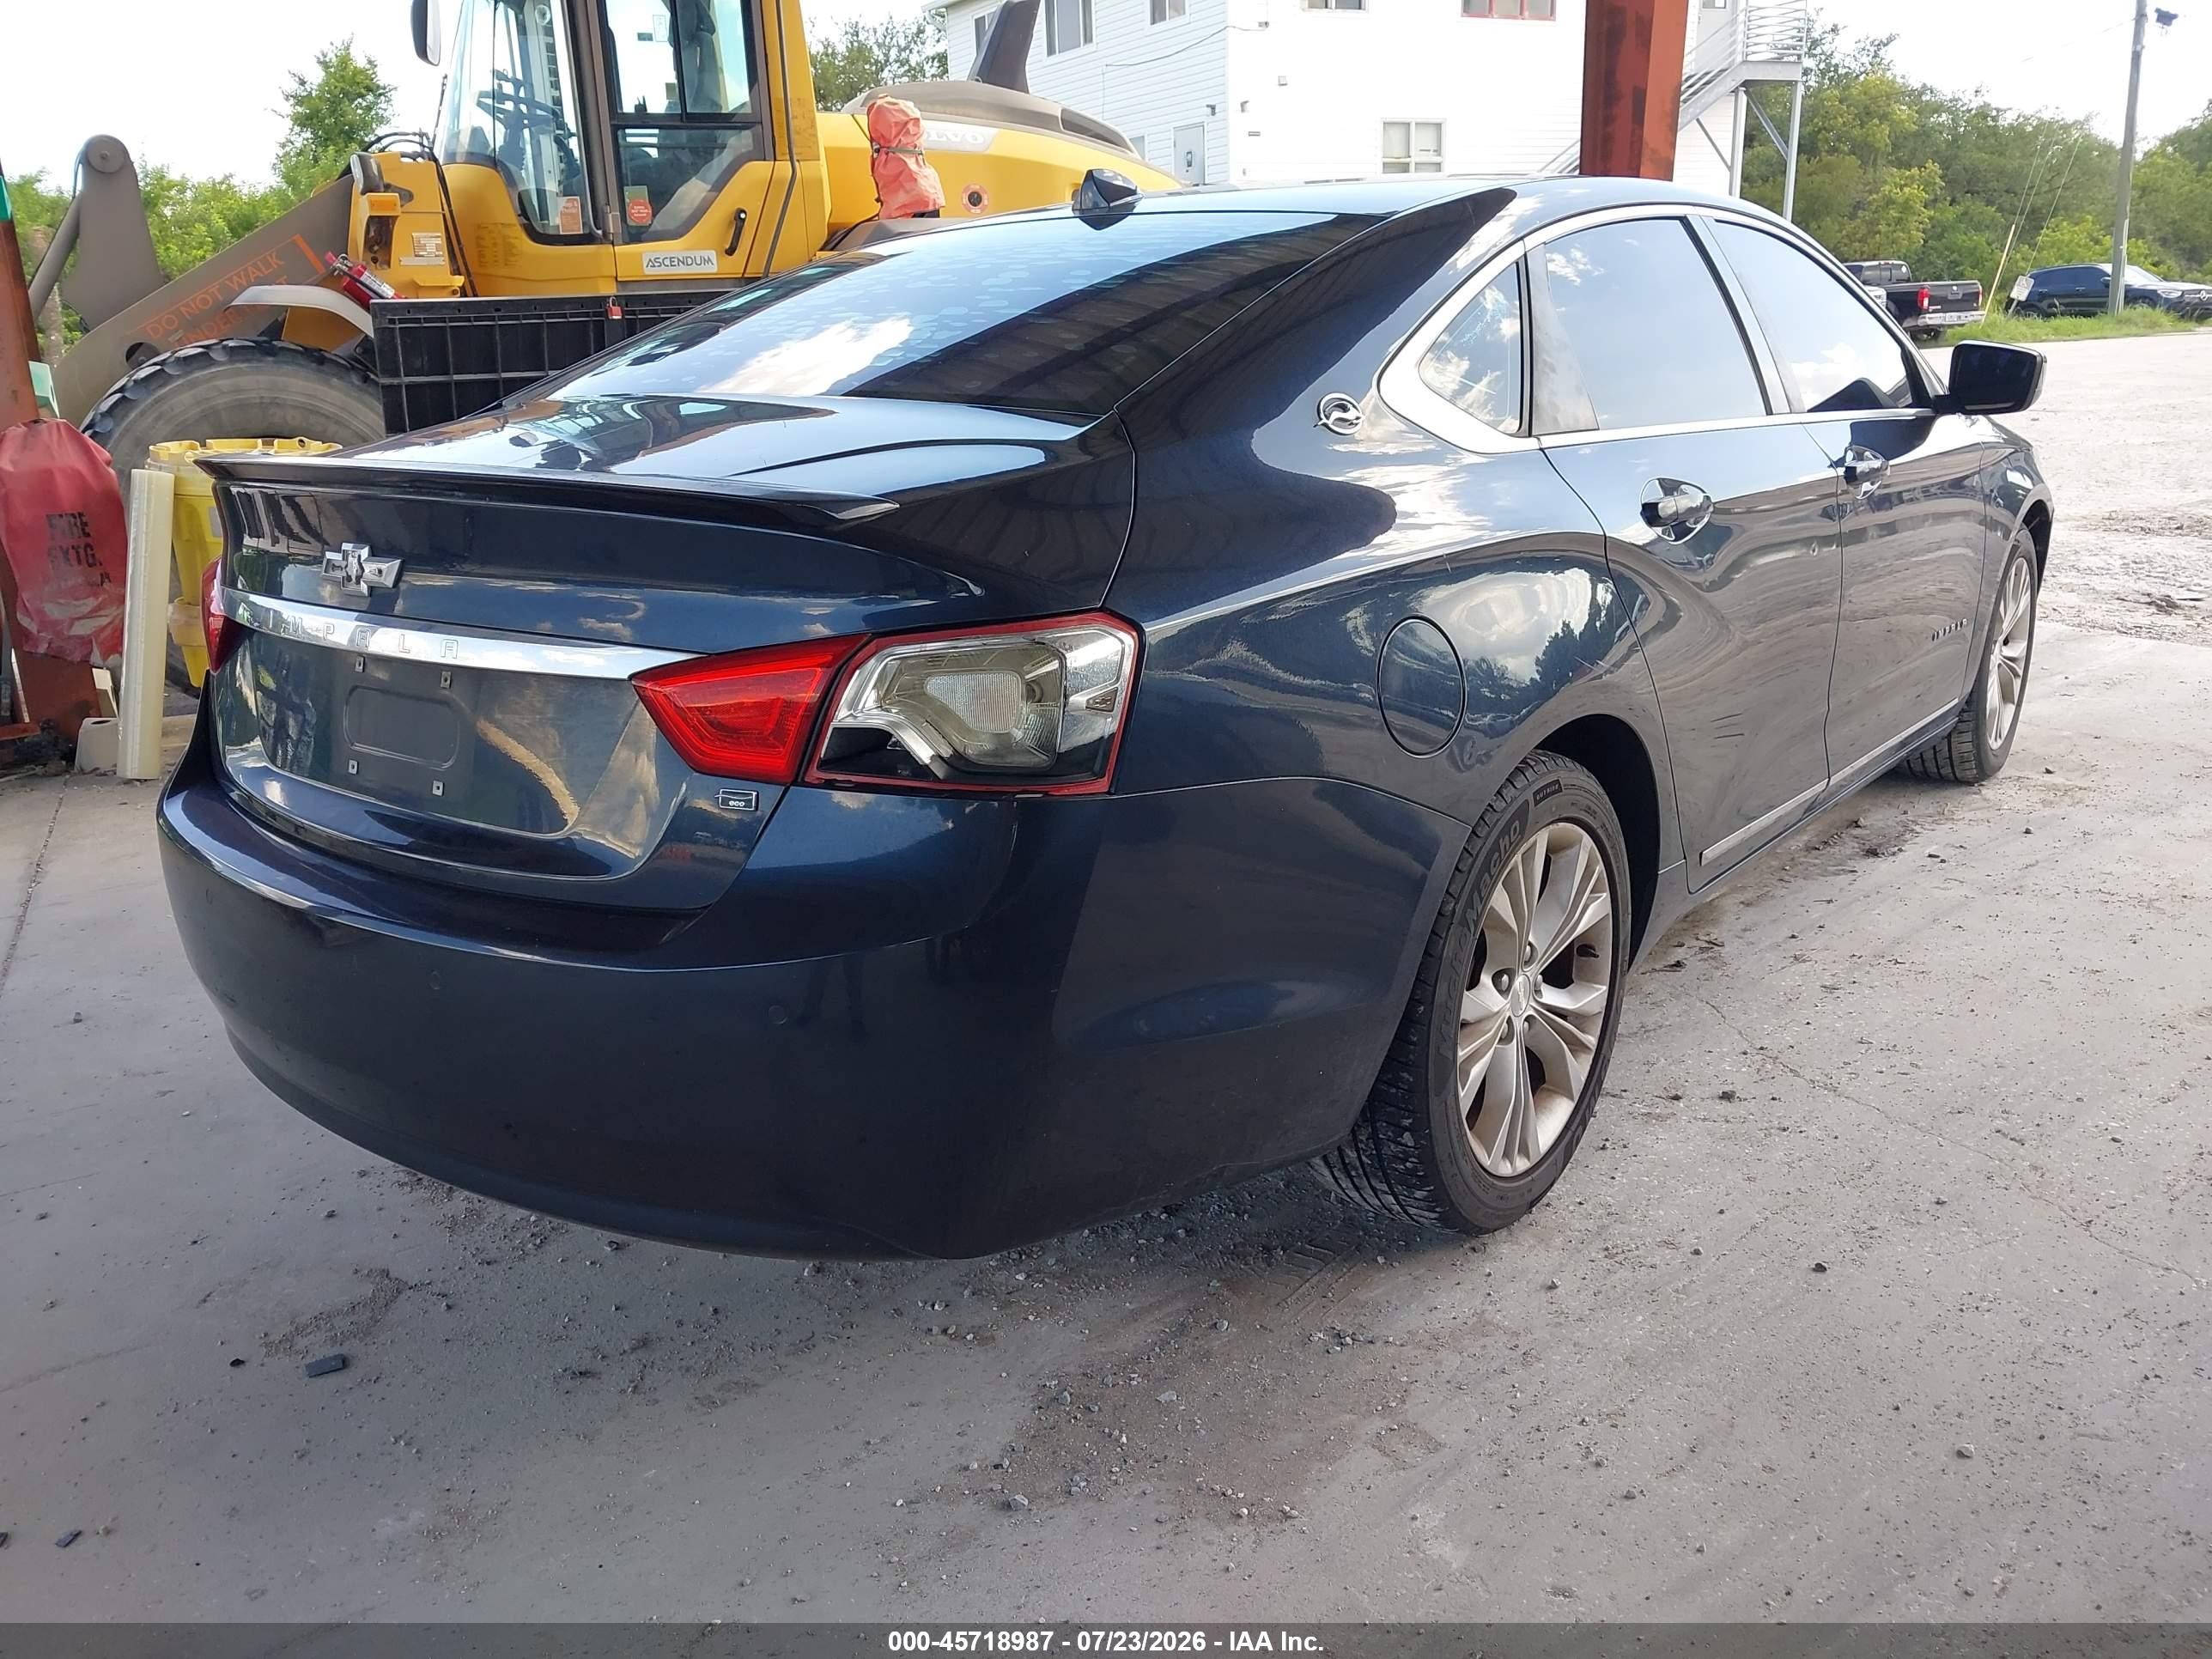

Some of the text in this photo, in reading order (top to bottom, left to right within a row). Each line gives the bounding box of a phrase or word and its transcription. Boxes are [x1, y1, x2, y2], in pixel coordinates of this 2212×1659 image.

[145, 315, 179, 340] DO
[179, 285, 224, 320] NOT
[224, 251, 285, 292] WALK
[646, 255, 714, 269] ASCENDUM
[268, 609, 459, 659] IMPALA
[1464, 818, 1521, 934] Macho
